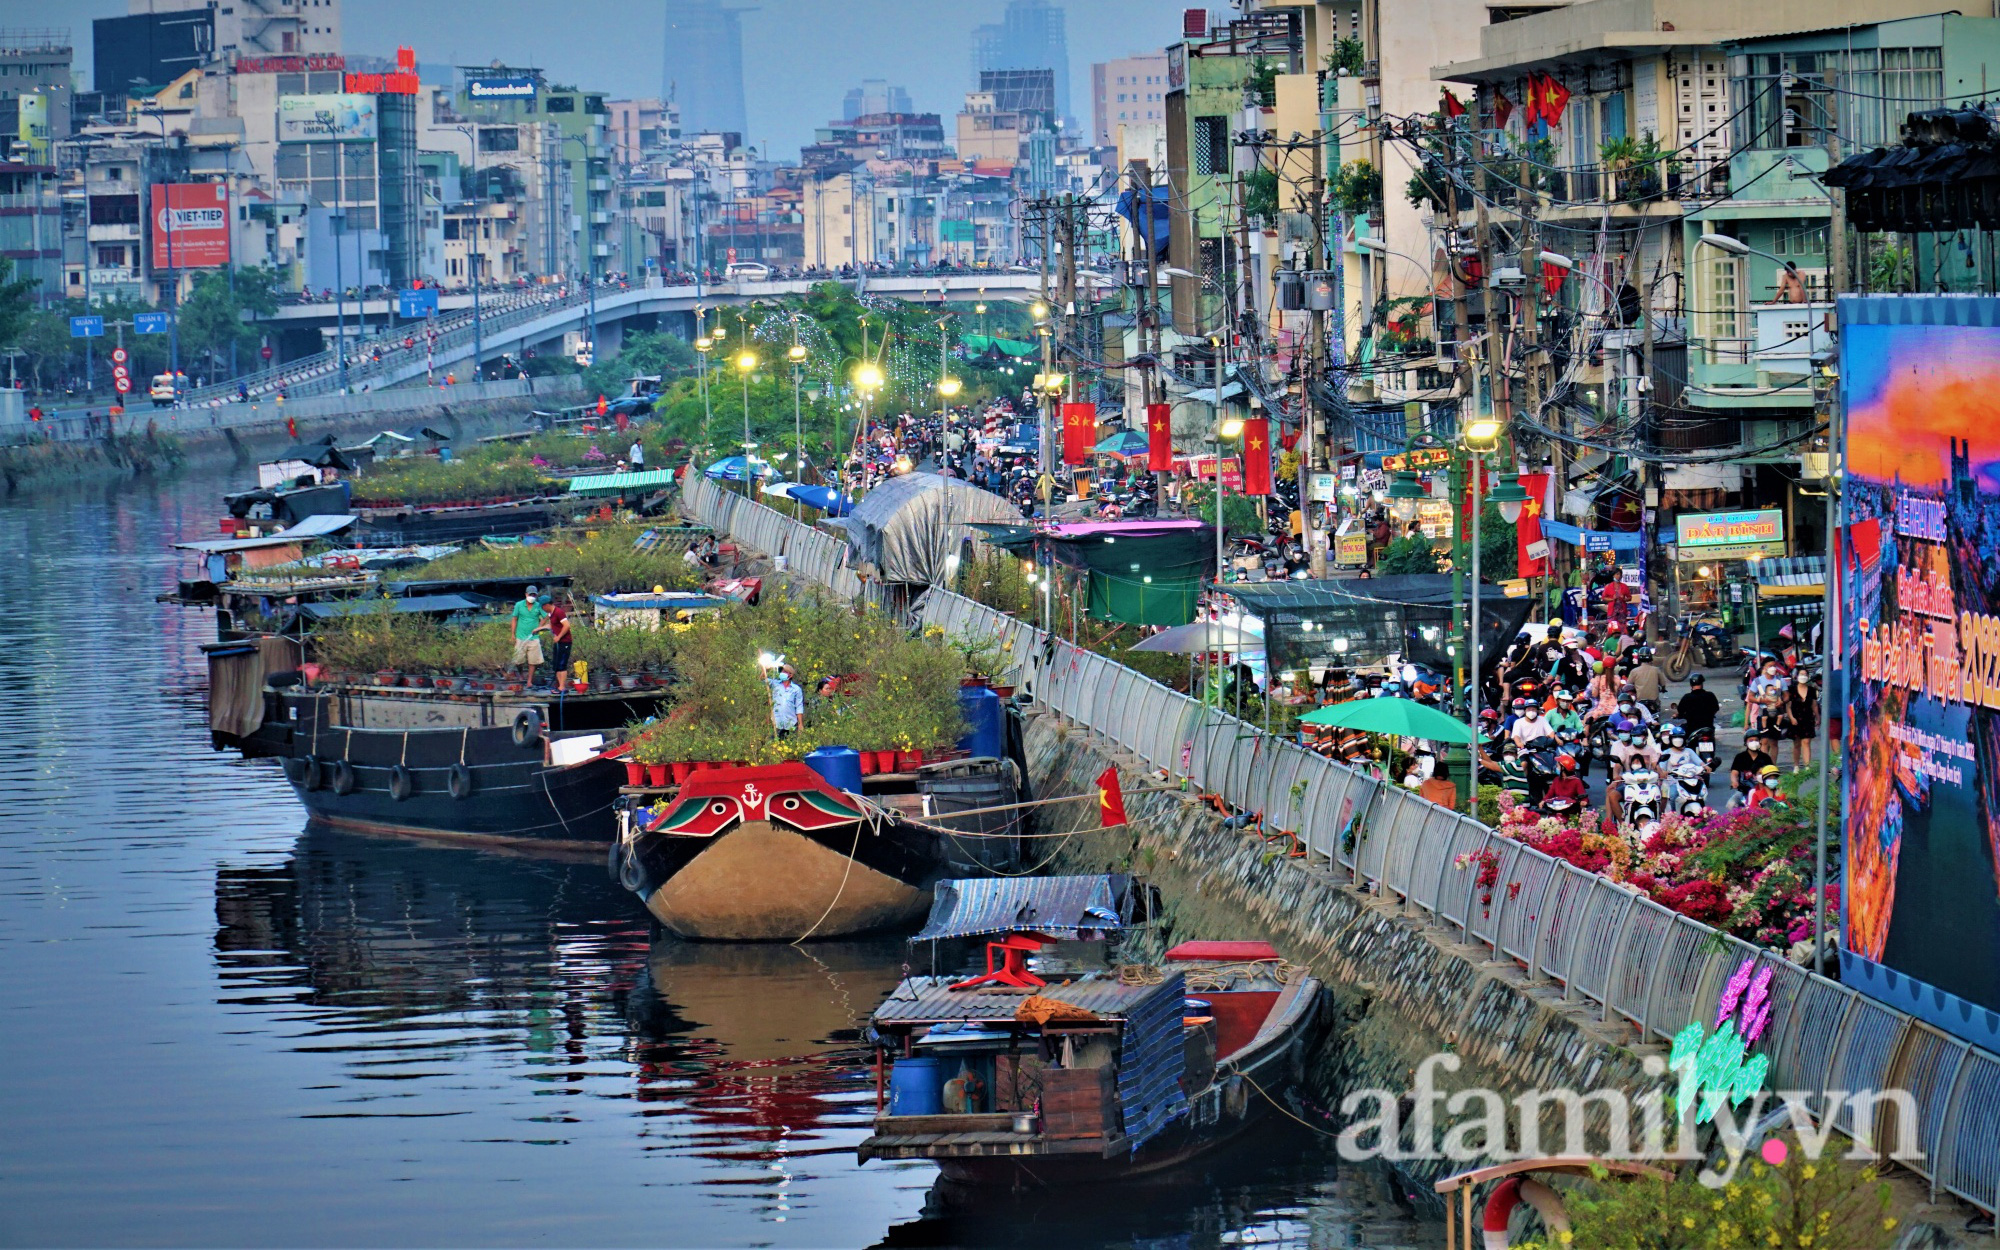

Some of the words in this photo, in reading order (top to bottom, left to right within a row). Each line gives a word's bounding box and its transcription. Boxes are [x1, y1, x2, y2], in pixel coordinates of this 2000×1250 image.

[471, 82, 534, 96] Sacombank
[303, 125, 346, 134] IMPLANT
[1961, 611, 2000, 711] 2022
